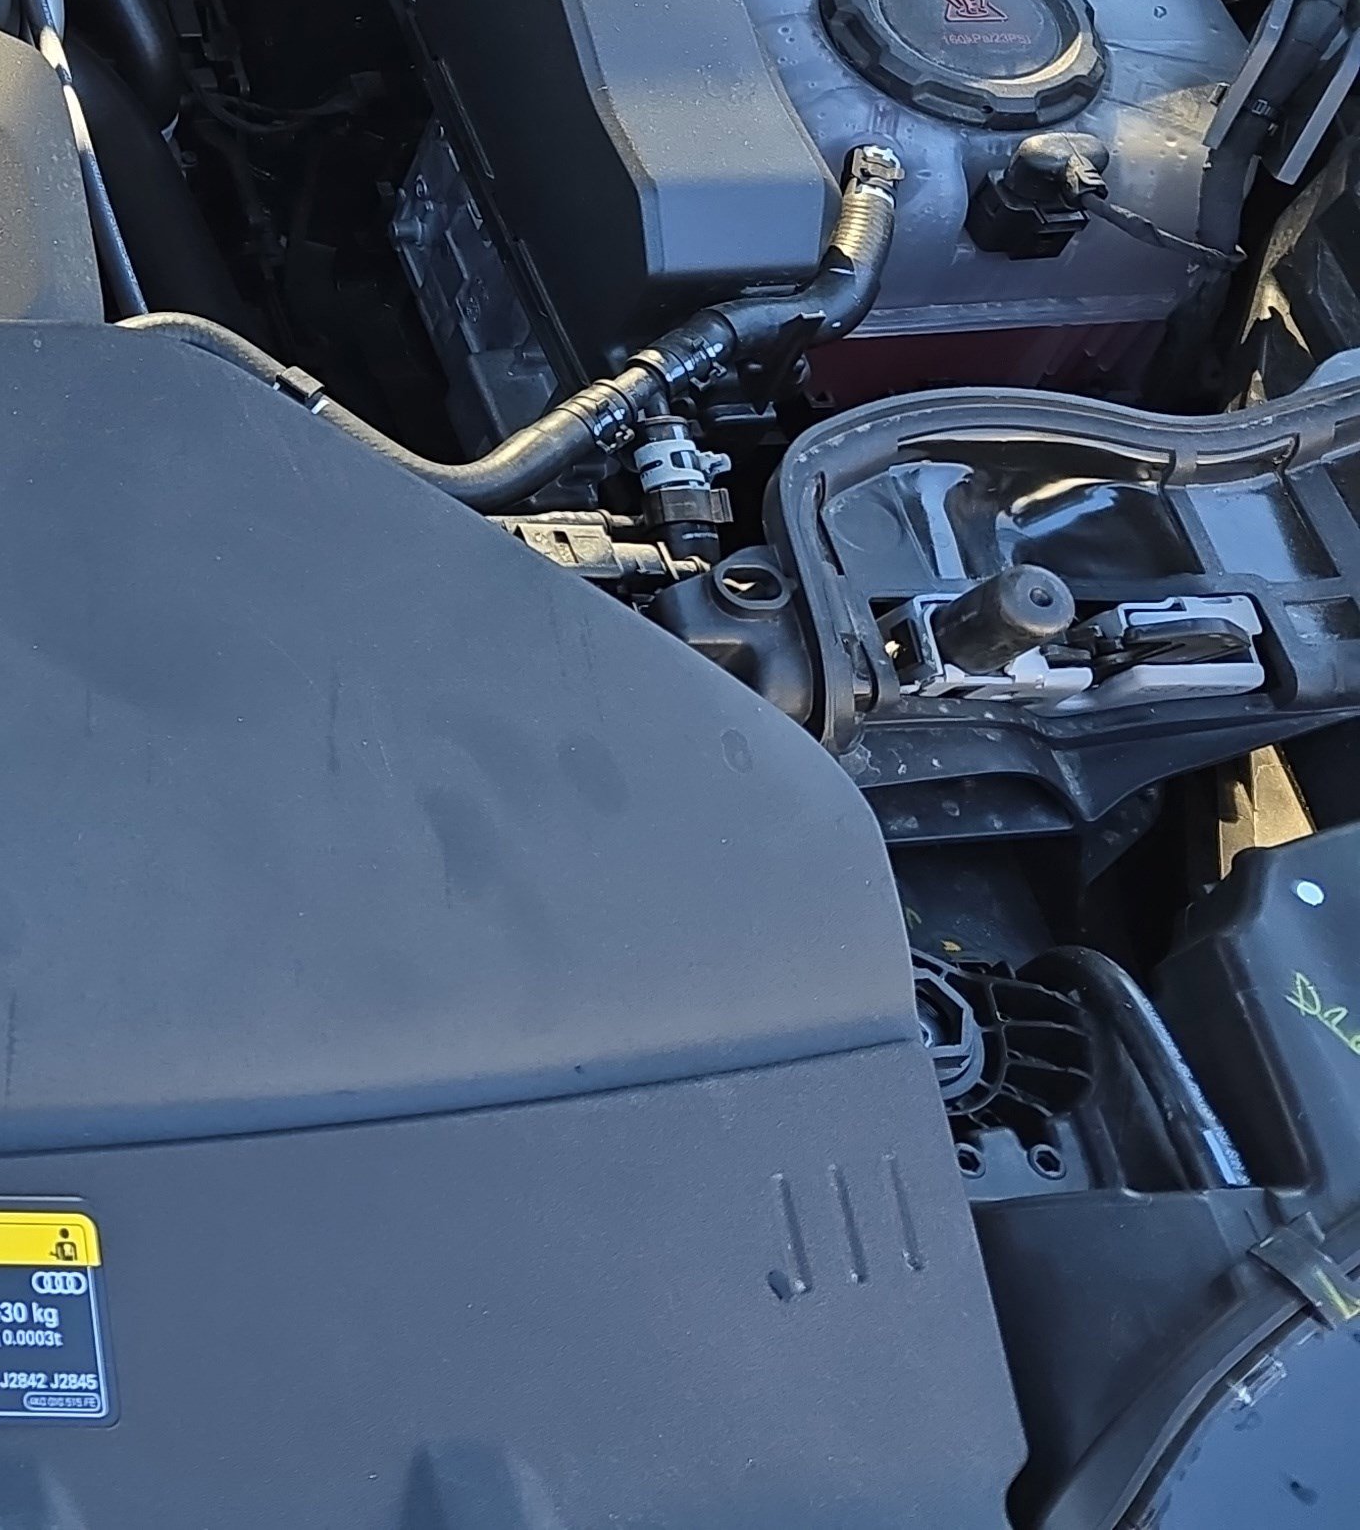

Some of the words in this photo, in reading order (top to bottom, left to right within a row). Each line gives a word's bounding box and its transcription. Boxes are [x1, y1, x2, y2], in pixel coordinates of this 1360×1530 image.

[32, 1302, 59, 1328] kg
[0, 1371, 48, 1389] J2842
[50, 1373, 98, 1390] J2845
